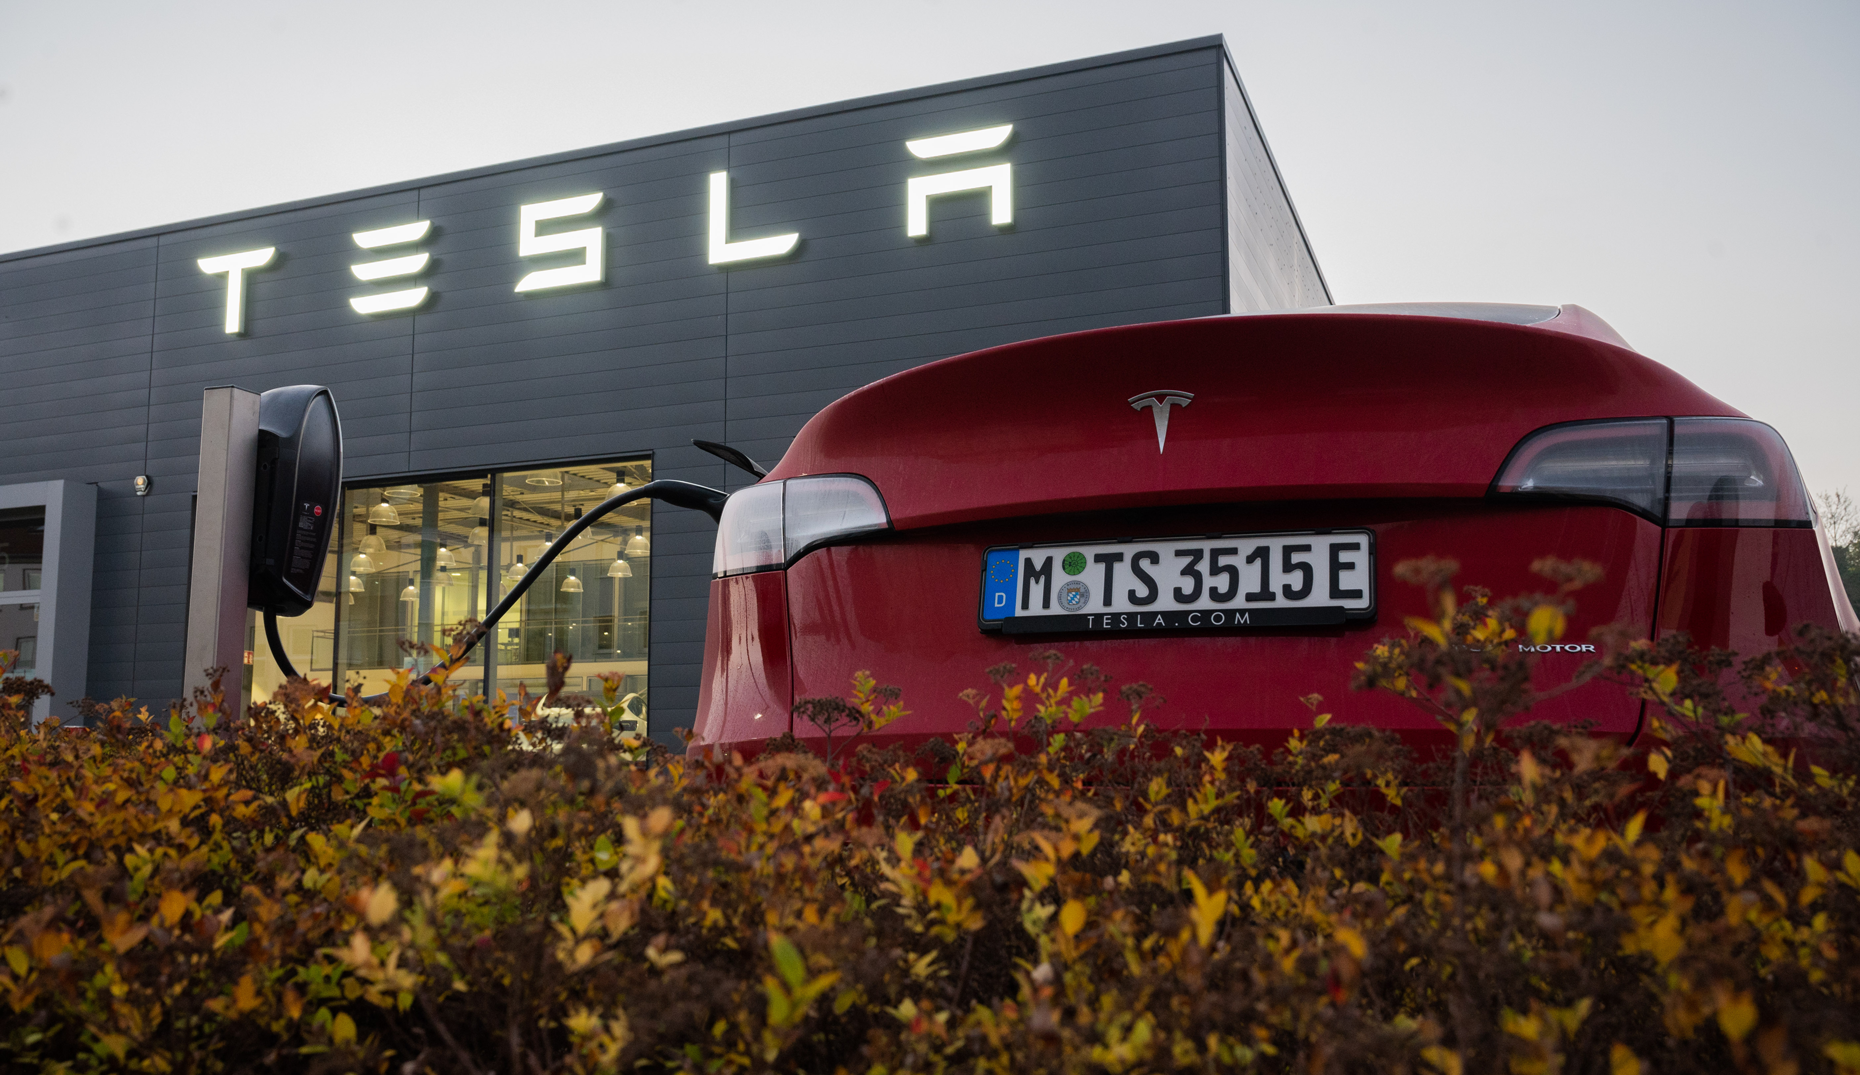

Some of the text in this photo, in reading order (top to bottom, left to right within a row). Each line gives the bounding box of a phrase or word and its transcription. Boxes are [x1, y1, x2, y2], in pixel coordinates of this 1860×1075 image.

[197, 124, 1014, 335] TESLA
[1021, 556, 1053, 610] M
[994, 592, 1007, 608] D
[1087, 611, 1251, 629] TESLA.COM
[1518, 644, 1596, 653] MOTOR
